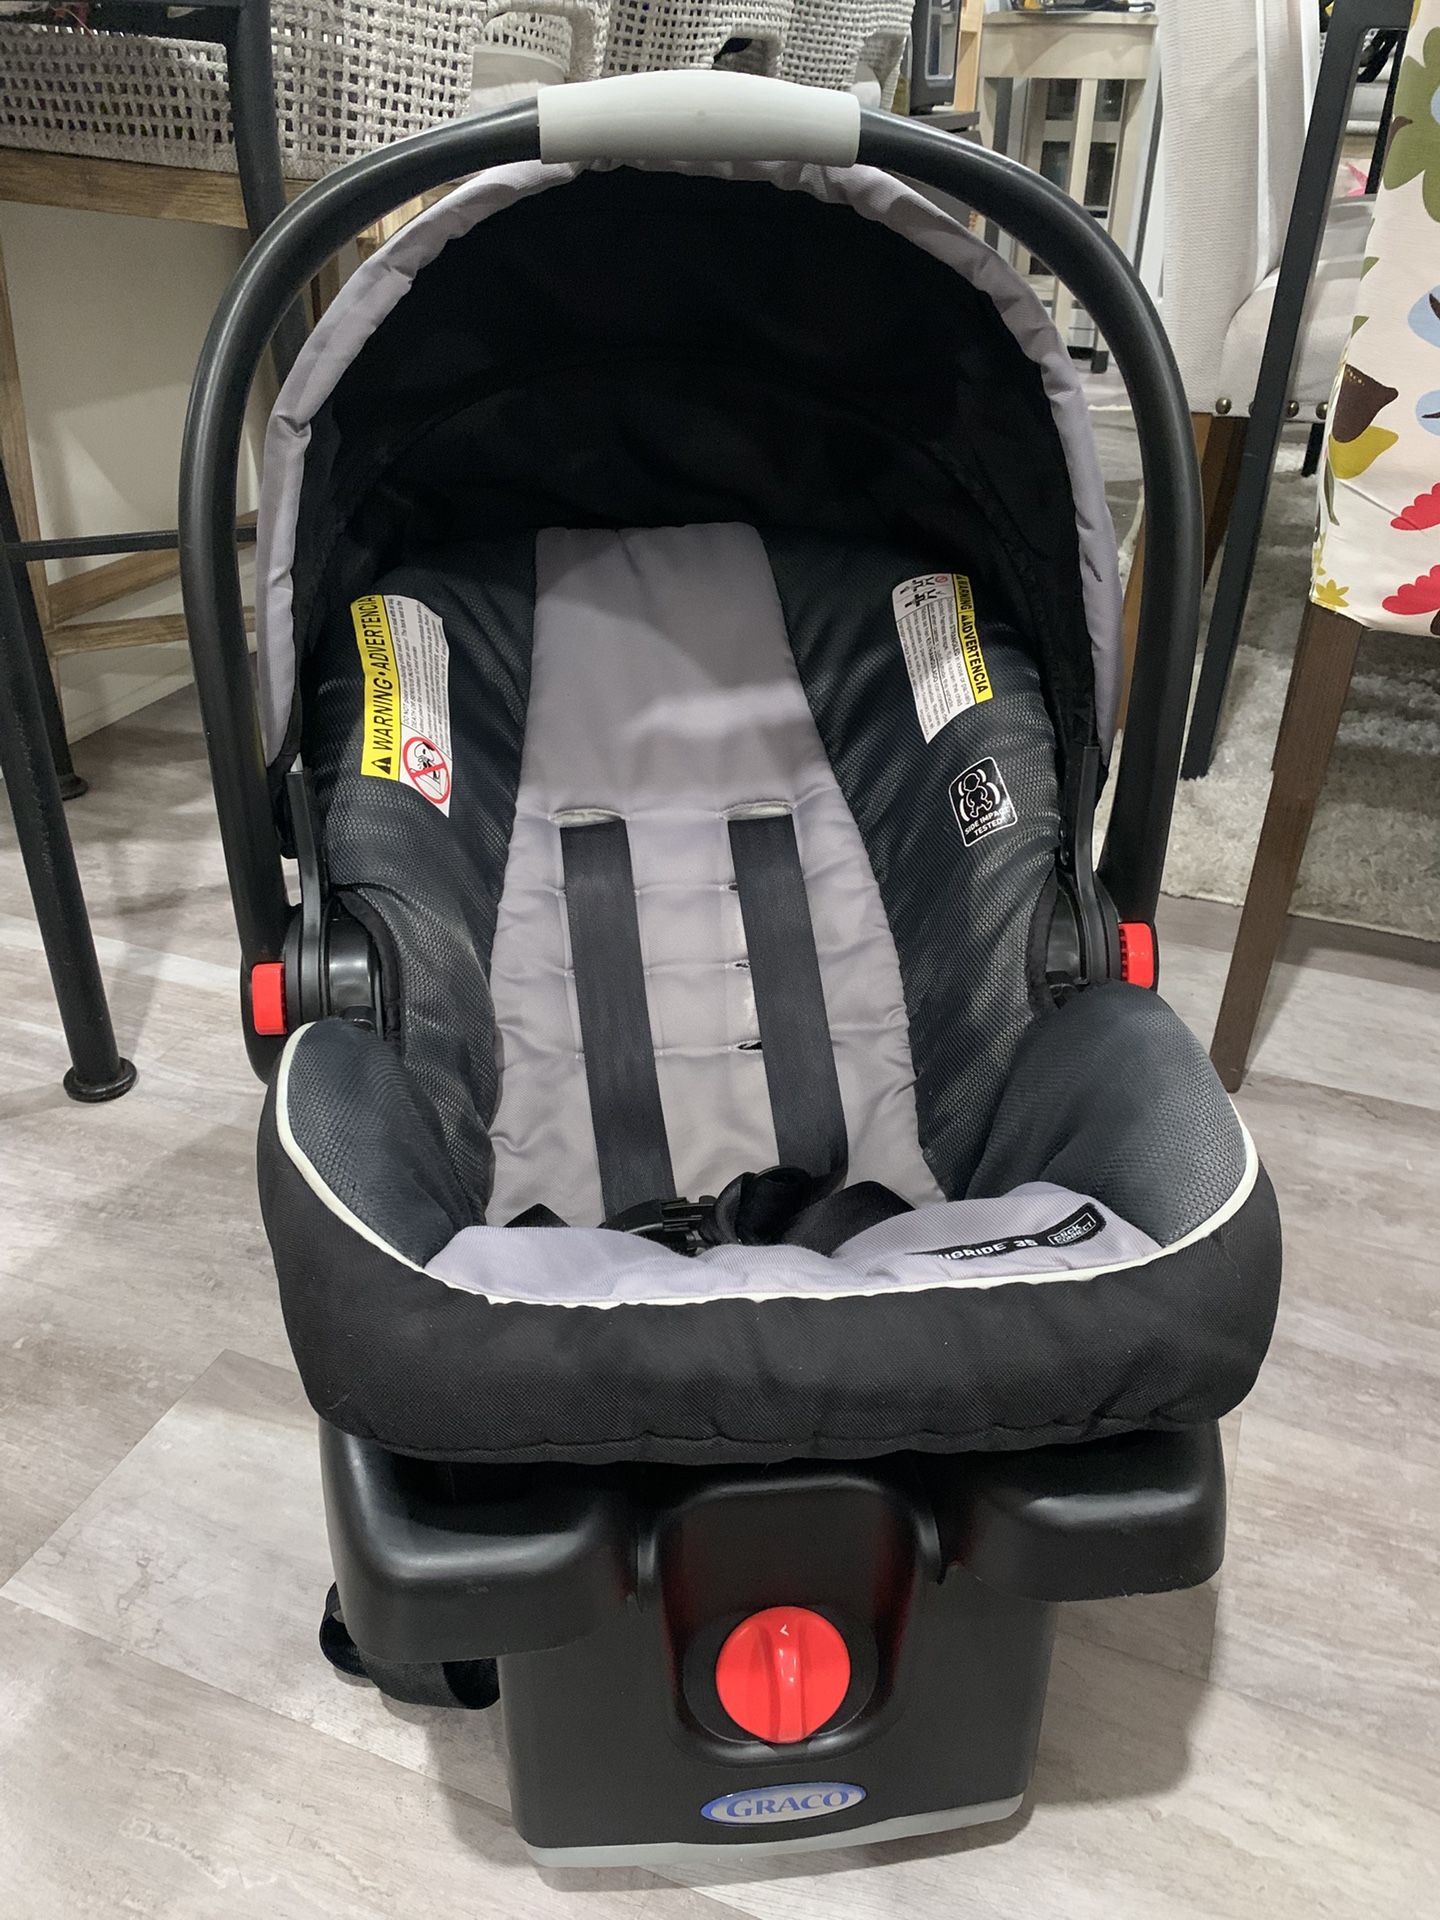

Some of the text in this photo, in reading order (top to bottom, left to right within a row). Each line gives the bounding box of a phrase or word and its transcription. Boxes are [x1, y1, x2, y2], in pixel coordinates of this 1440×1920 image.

[961, 622, 988, 694] ADVERTENCIA
[358, 596, 393, 750] WARNING ADVERTENCIA
[965, 820, 980, 835] SIDE
[974, 819, 1002, 836] TESTED
[1013, 1239, 1038, 1248] 35
[726, 1791, 849, 1817] GRACO
